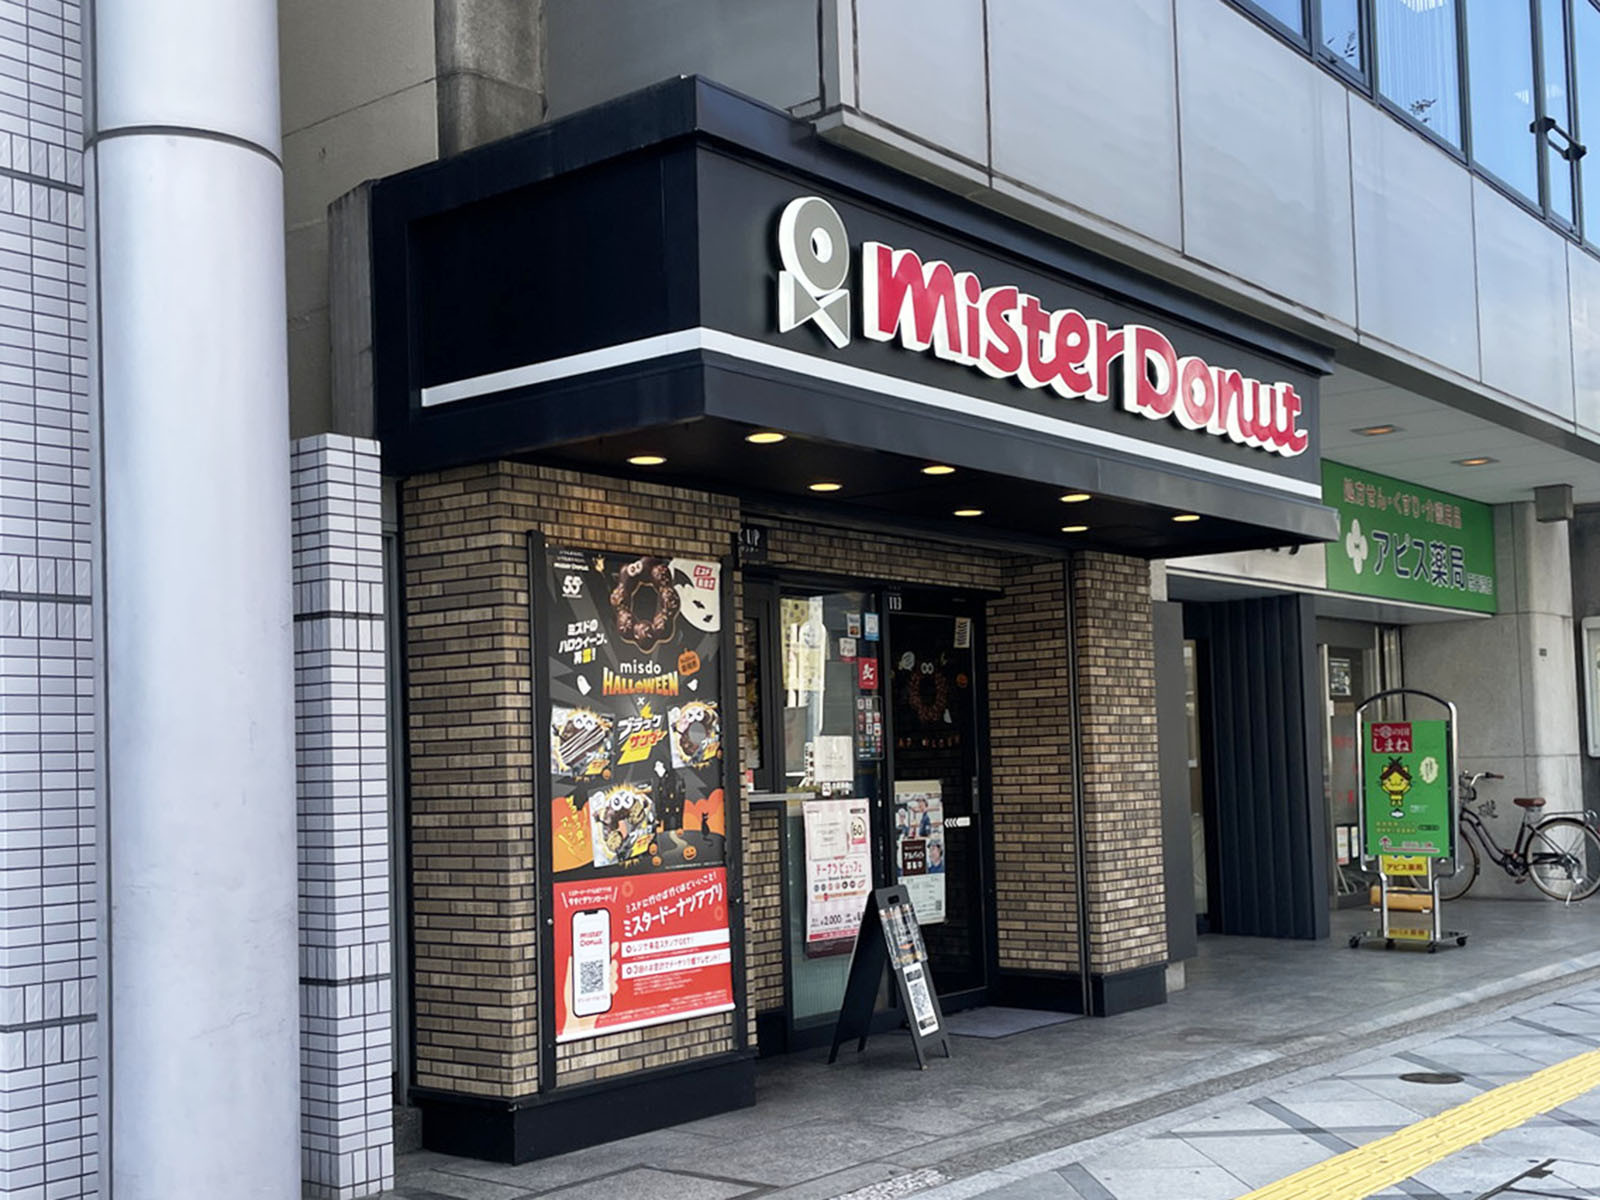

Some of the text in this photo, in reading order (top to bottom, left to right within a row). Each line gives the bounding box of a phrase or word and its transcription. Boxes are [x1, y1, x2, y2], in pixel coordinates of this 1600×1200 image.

[1123, 323, 1309, 458] Donut
[602, 667, 679, 696] HALLOWEEN
[620, 659, 661, 675] misdo
[1373, 738, 1410, 752] しまね
[623, 883, 723, 938] ミスタードーナツアプリ
